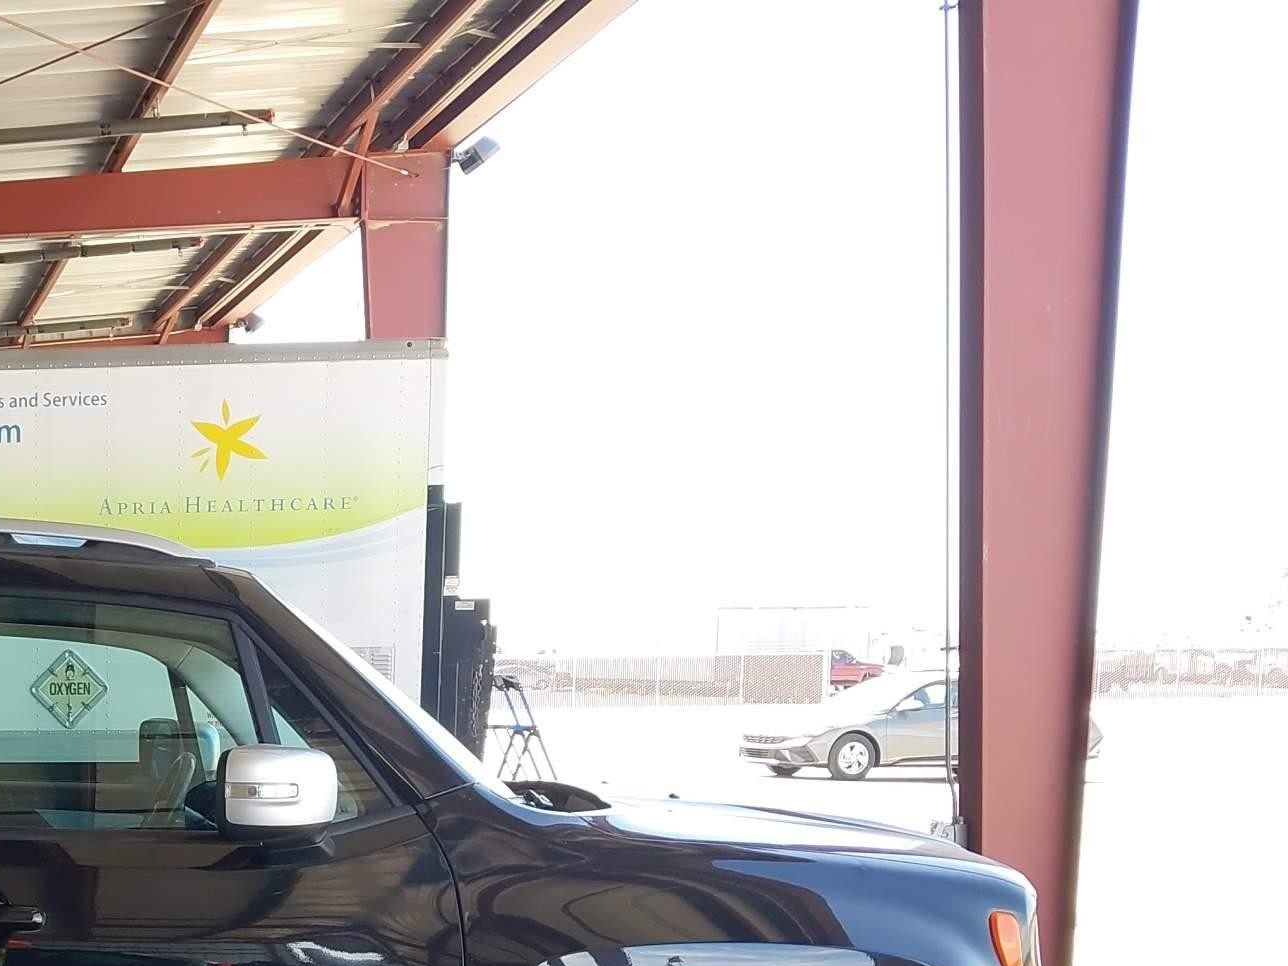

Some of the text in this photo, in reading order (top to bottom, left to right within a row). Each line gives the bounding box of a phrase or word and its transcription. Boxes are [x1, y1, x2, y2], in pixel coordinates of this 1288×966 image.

[8, 392, 39, 408] and
[42, 391, 108, 408] Services
[99, 496, 353, 515] APRIA HEALTHCARE
[49, 682, 91, 696] OXYGEN
